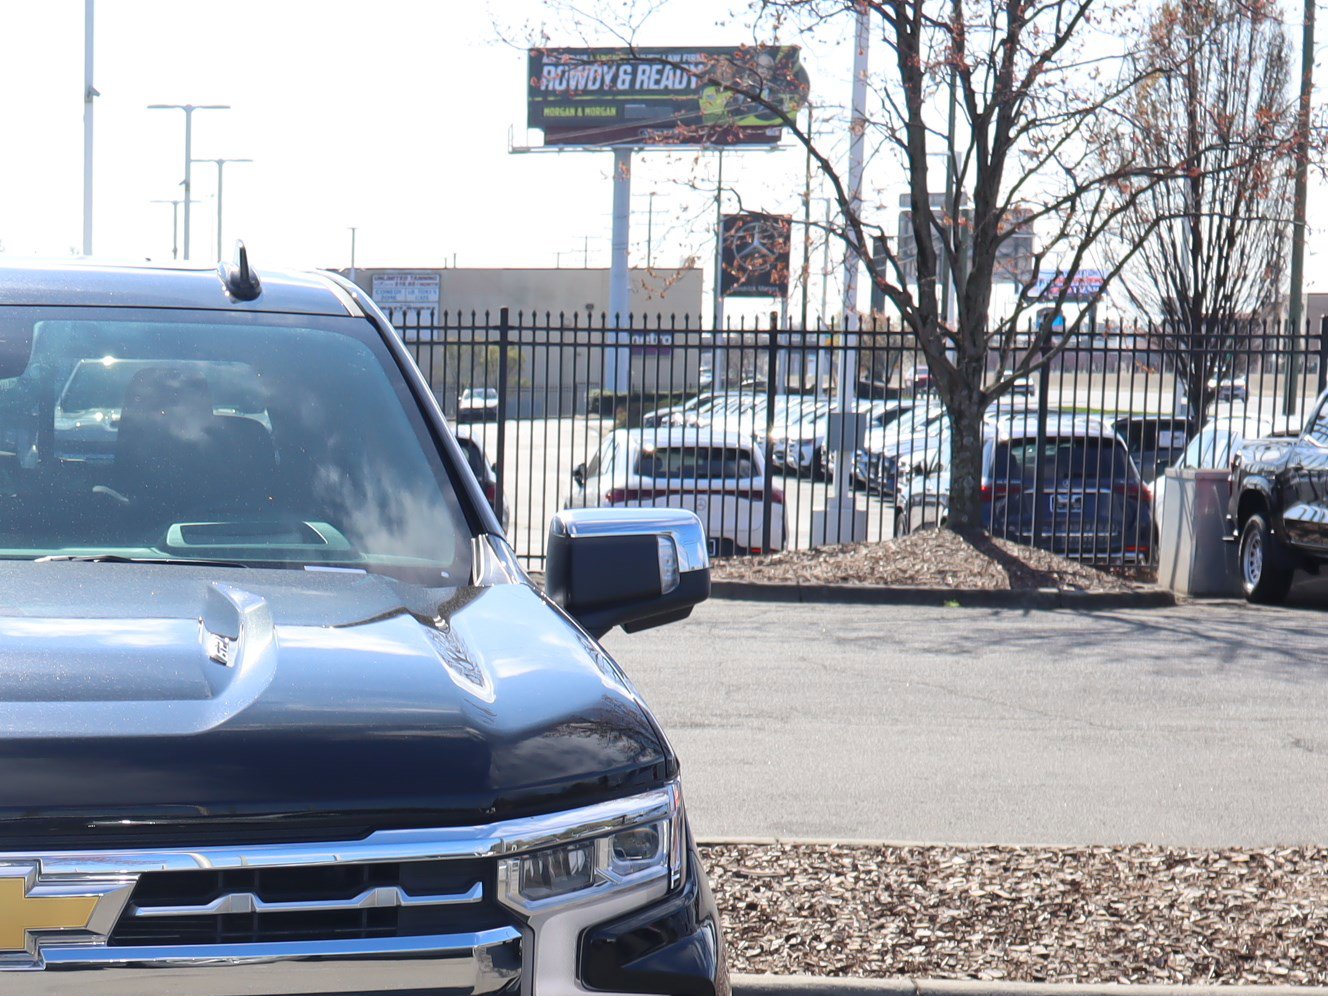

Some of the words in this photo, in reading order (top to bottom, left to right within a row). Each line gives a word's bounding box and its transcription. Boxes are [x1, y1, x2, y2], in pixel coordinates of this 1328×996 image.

[540, 64, 616, 91] ROWDY
[616, 64, 633, 90] &
[635, 64, 705, 90] READY
[544, 107, 575, 117] MORGAN
[584, 107, 617, 117] MORGAN
